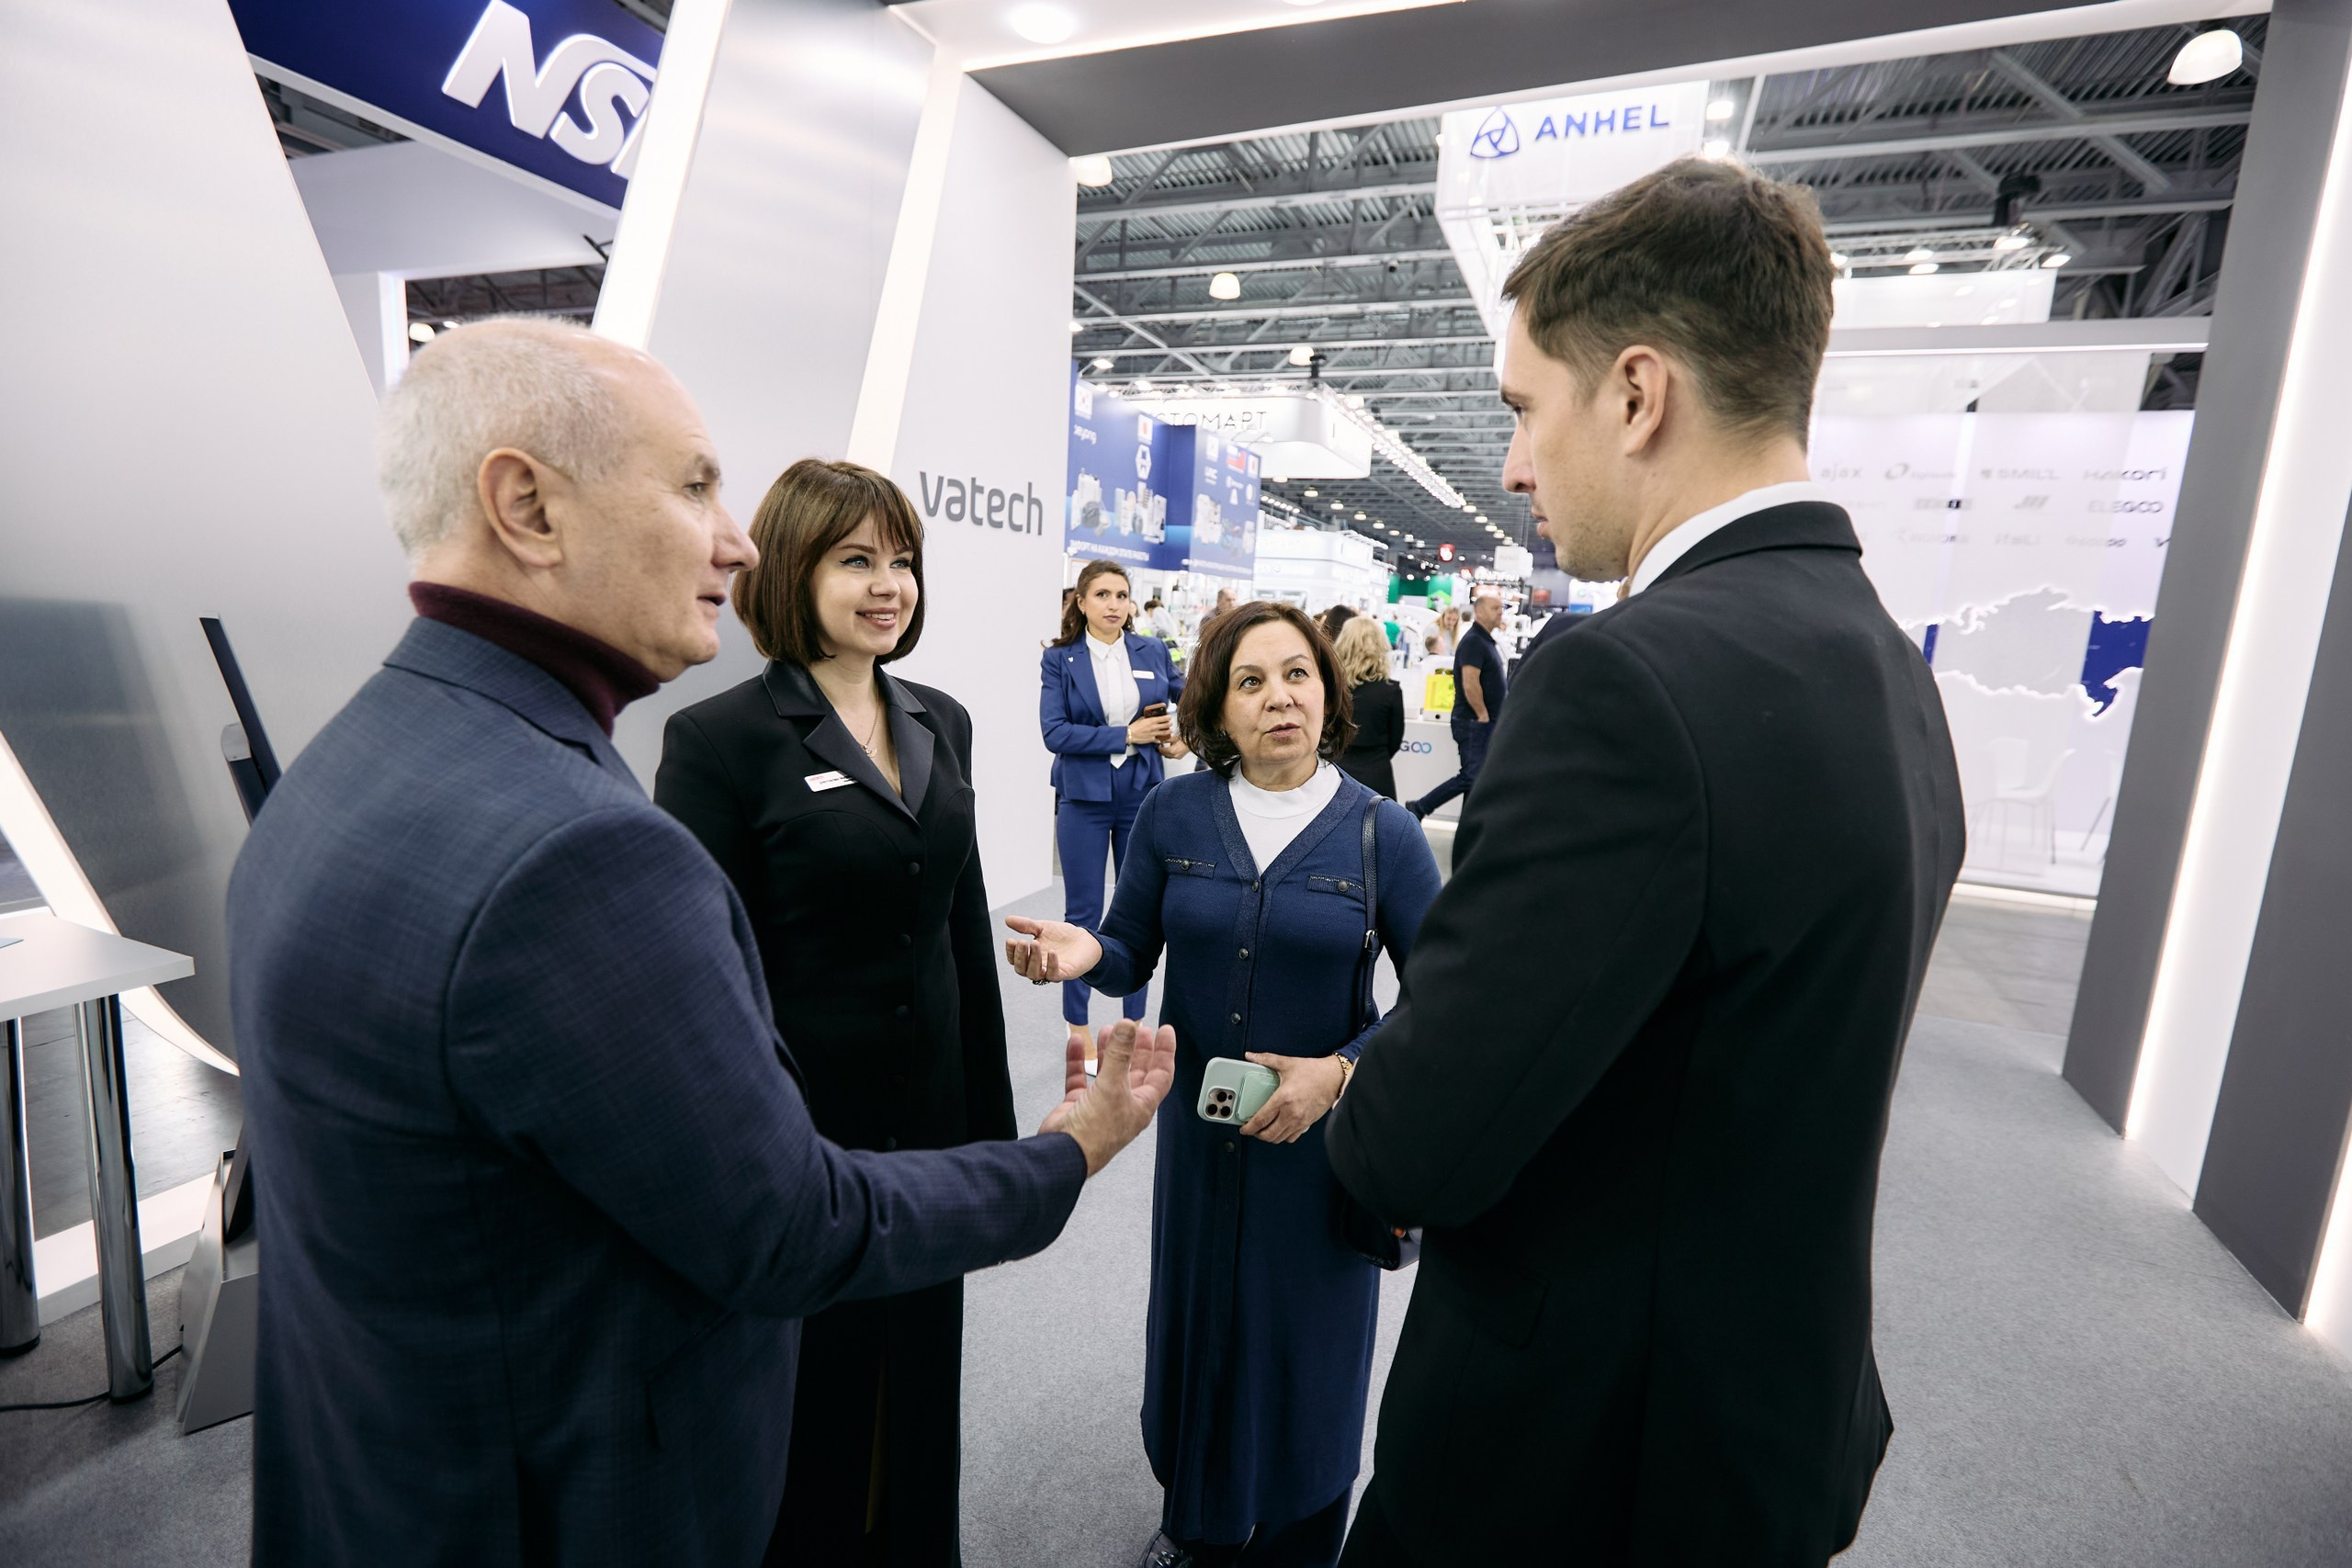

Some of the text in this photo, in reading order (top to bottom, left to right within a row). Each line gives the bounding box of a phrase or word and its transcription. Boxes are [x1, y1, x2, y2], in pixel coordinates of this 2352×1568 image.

[441, 0, 658, 180] NS
[1534, 105, 1669, 141] ANHEL
[920, 470, 1043, 536] vatech
